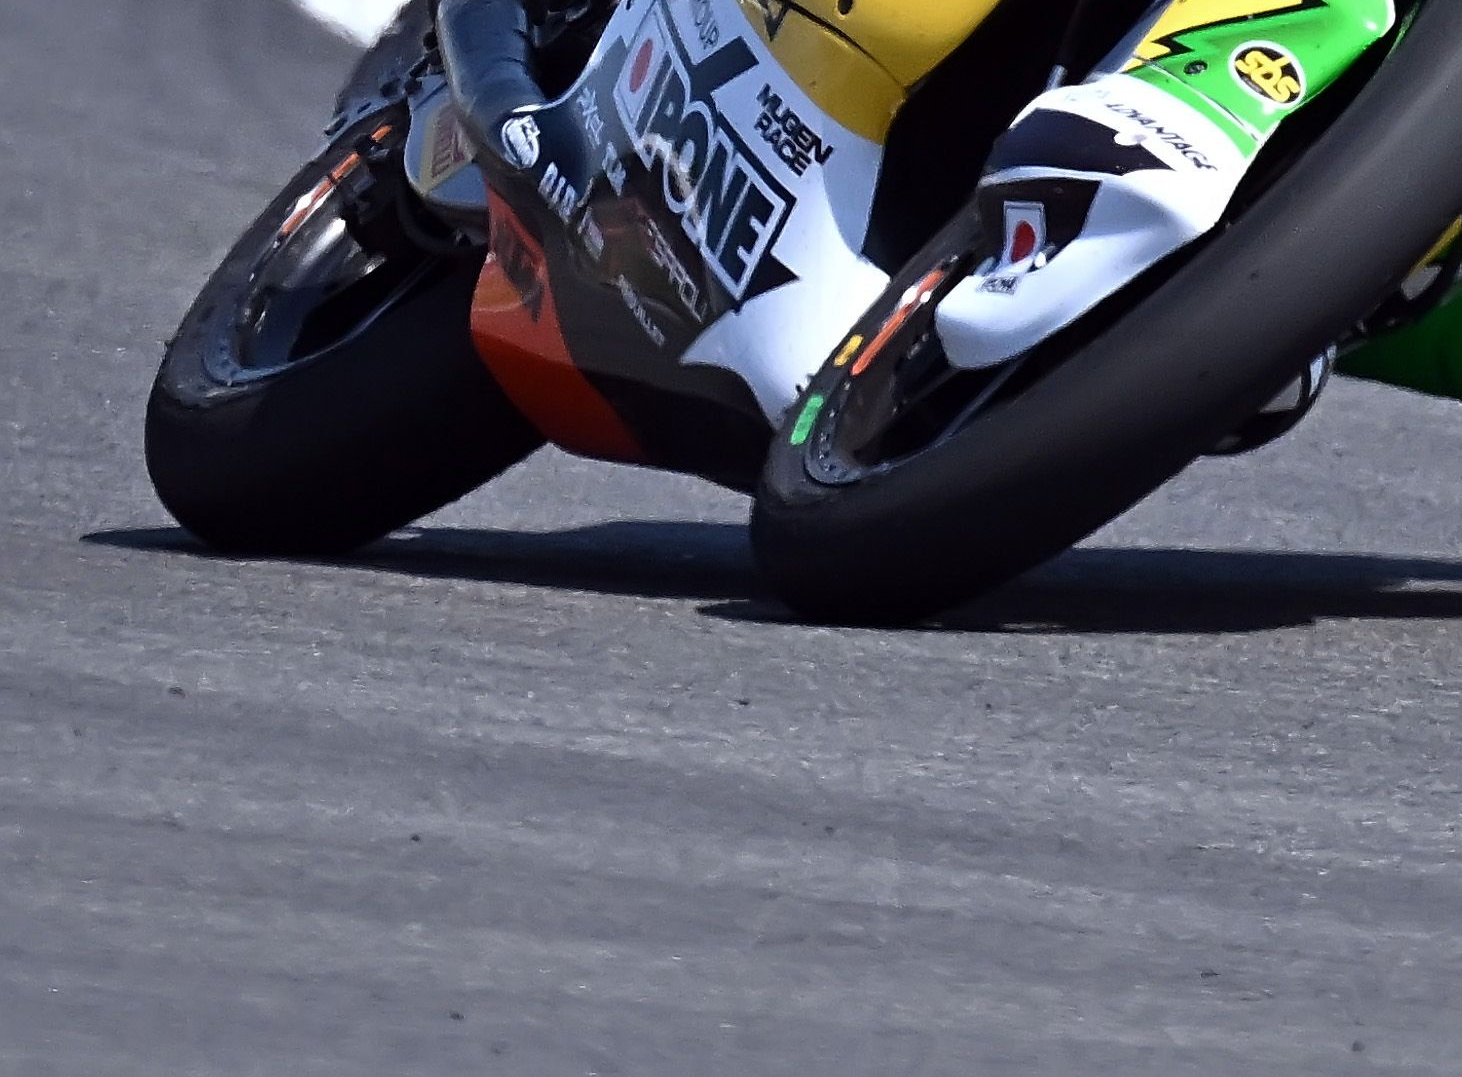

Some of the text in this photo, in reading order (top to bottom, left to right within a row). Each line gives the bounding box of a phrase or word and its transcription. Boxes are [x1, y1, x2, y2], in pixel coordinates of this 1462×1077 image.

[1234, 49, 1302, 104] sbs
[754, 112, 812, 177] RACE
[756, 83, 835, 166] MUGEN
[634, 50, 778, 286] IPONE
